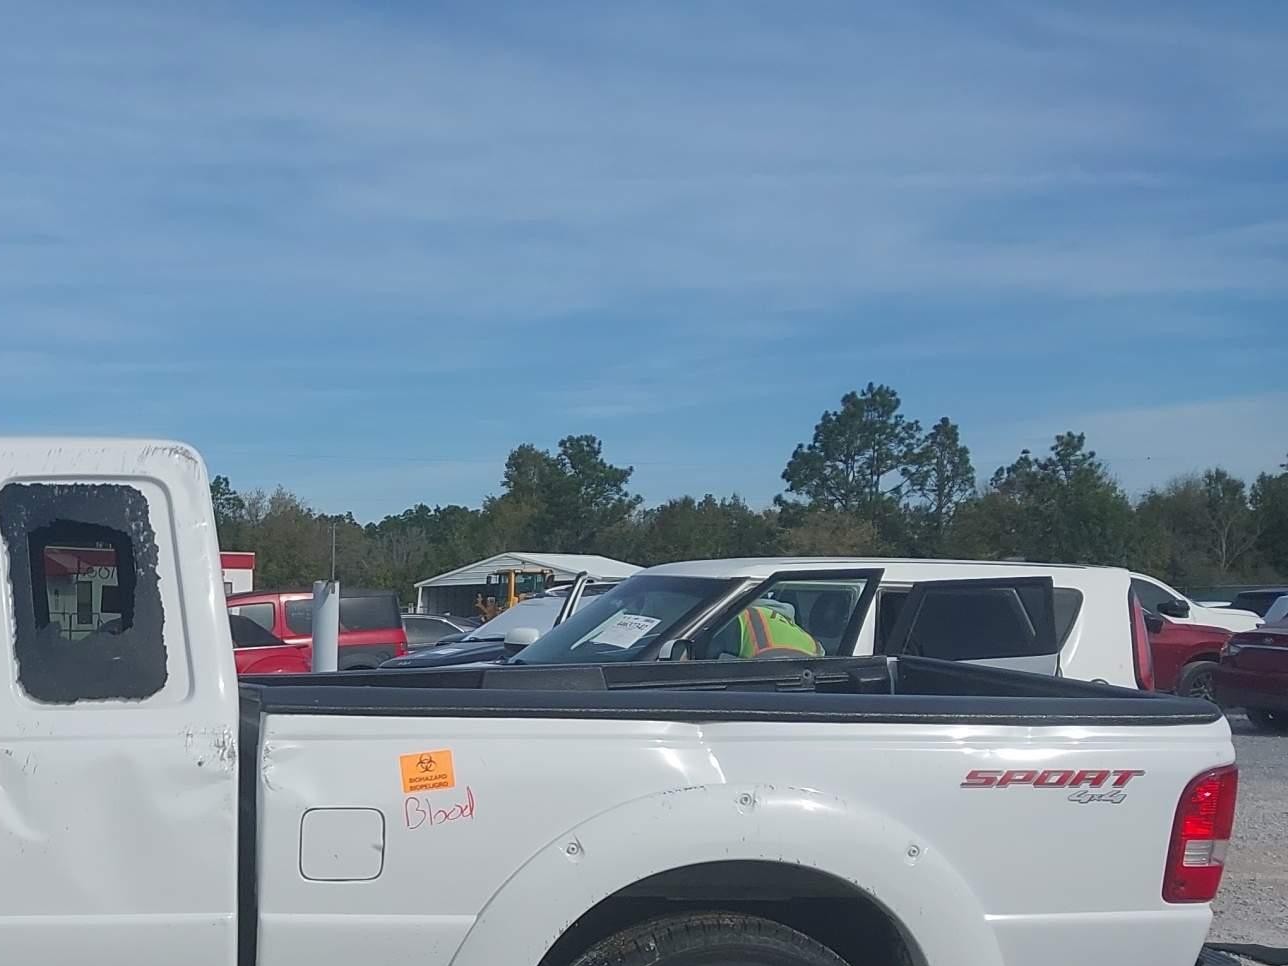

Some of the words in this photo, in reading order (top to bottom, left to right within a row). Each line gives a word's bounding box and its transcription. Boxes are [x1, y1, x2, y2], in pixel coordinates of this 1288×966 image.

[409, 774, 448, 783] BIOHAZARD
[960, 770, 1146, 788] SPORT
[409, 781, 449, 791] BIOPELIGRO
[1067, 790, 1127, 804] 4x4
[405, 786, 474, 829] Blood
